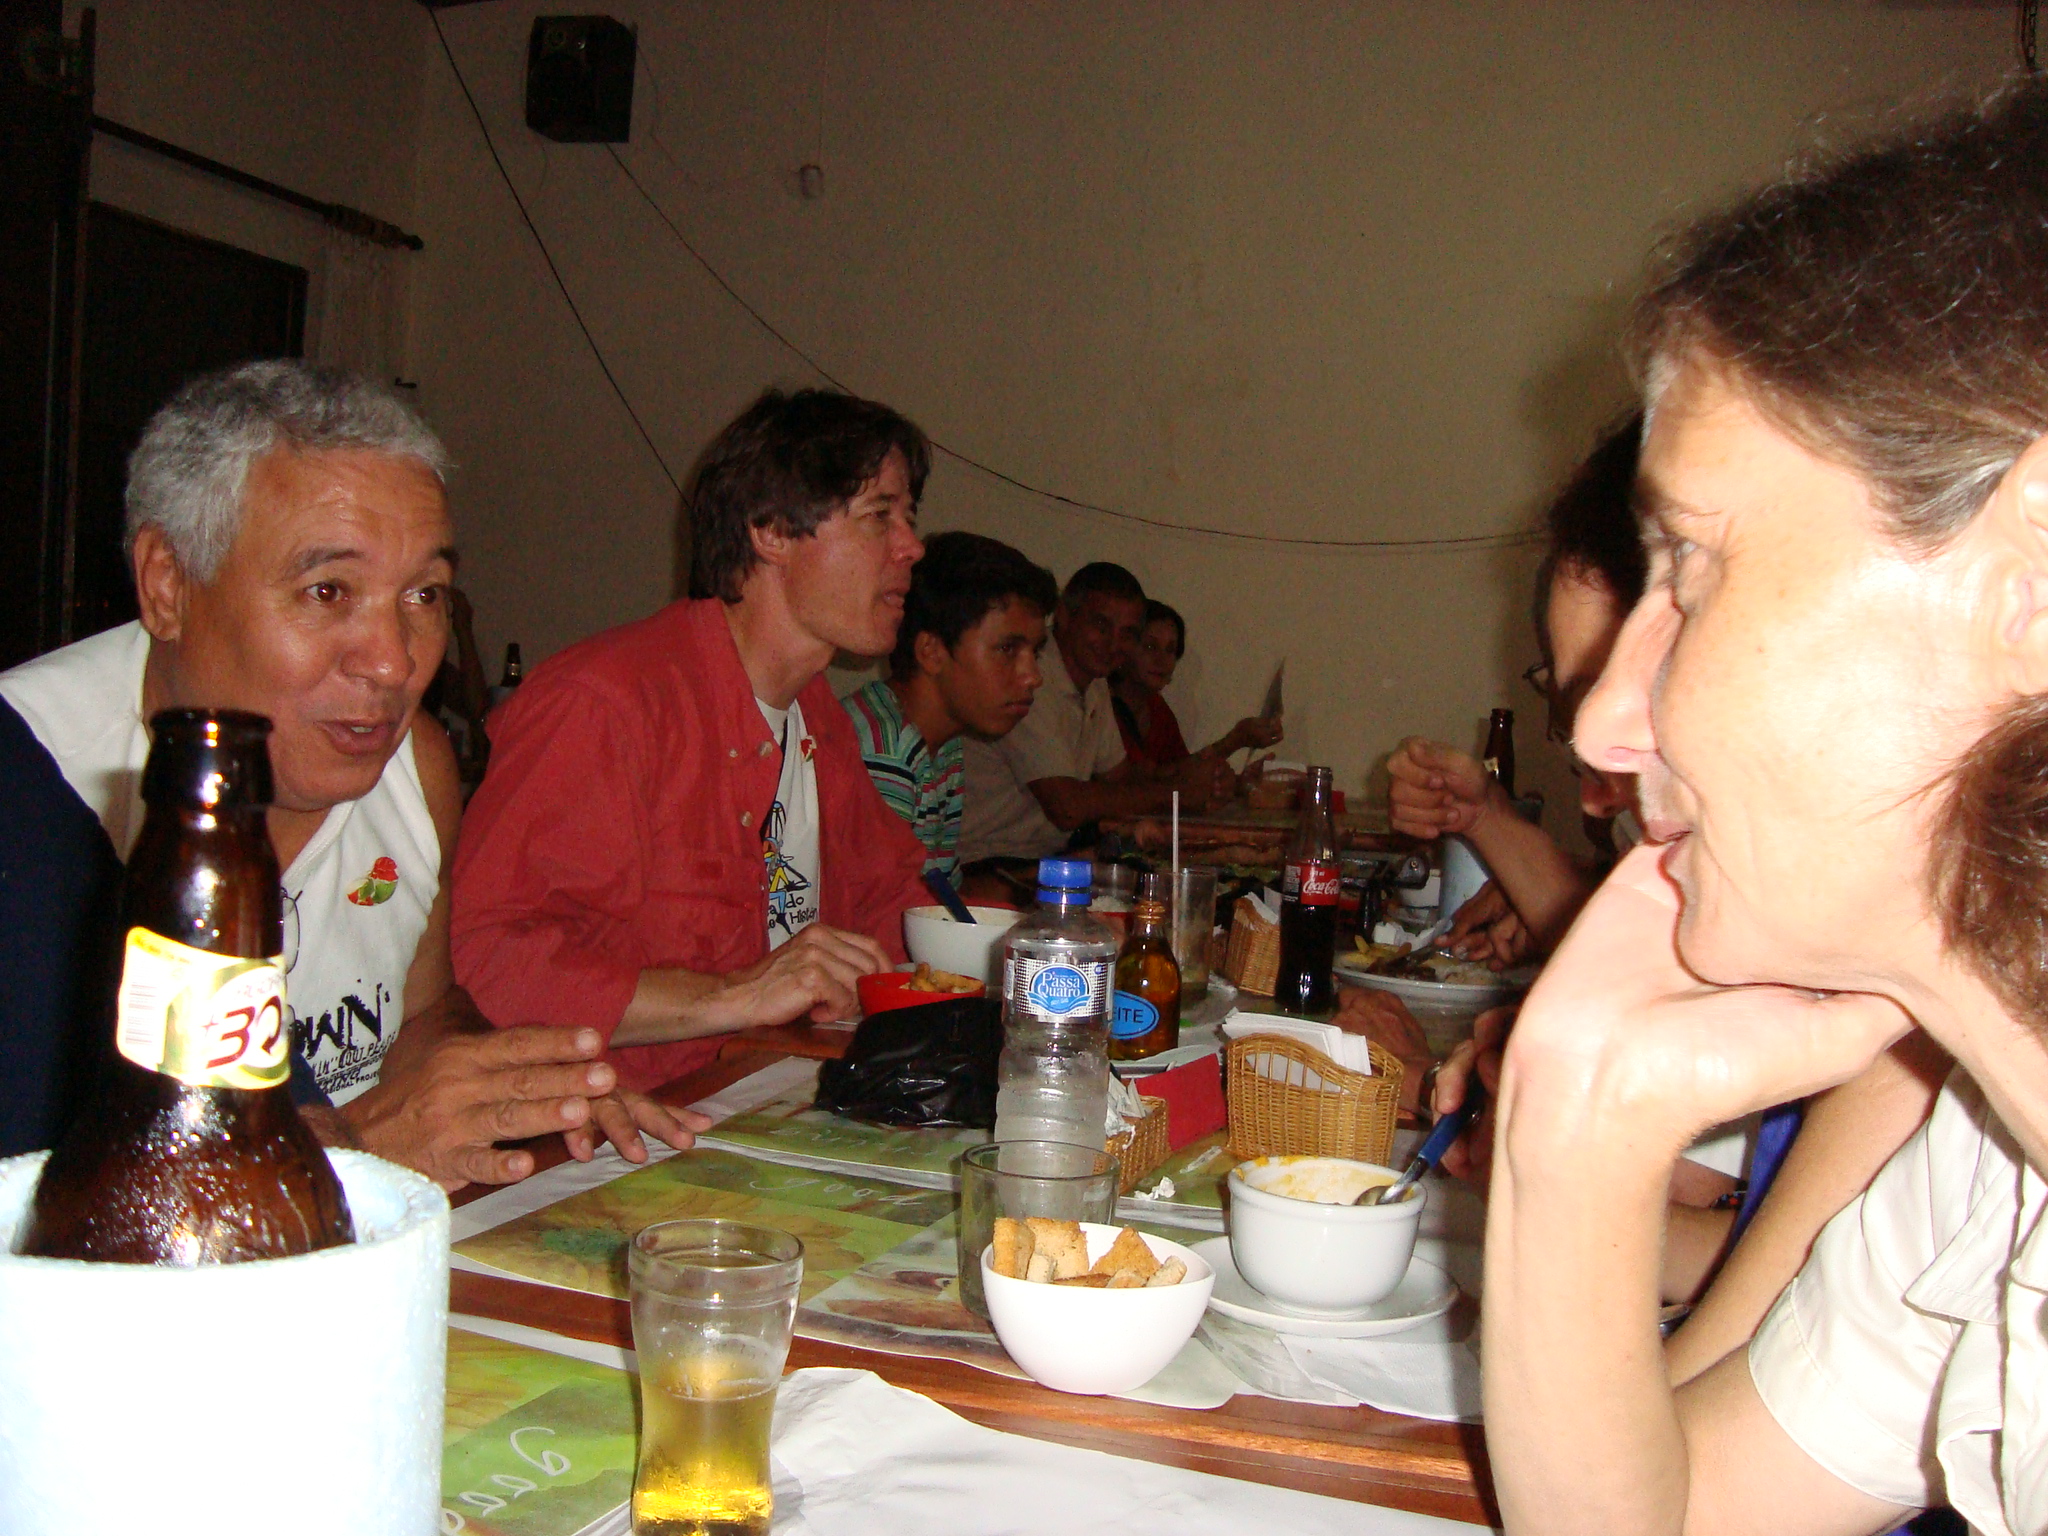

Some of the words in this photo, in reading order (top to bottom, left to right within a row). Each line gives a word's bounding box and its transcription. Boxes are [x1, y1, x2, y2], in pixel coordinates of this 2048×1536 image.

[1042, 972, 1080, 988] Passa
[1038, 983, 1080, 998] Quatro
[1113, 1007, 1144, 1024] ITE
